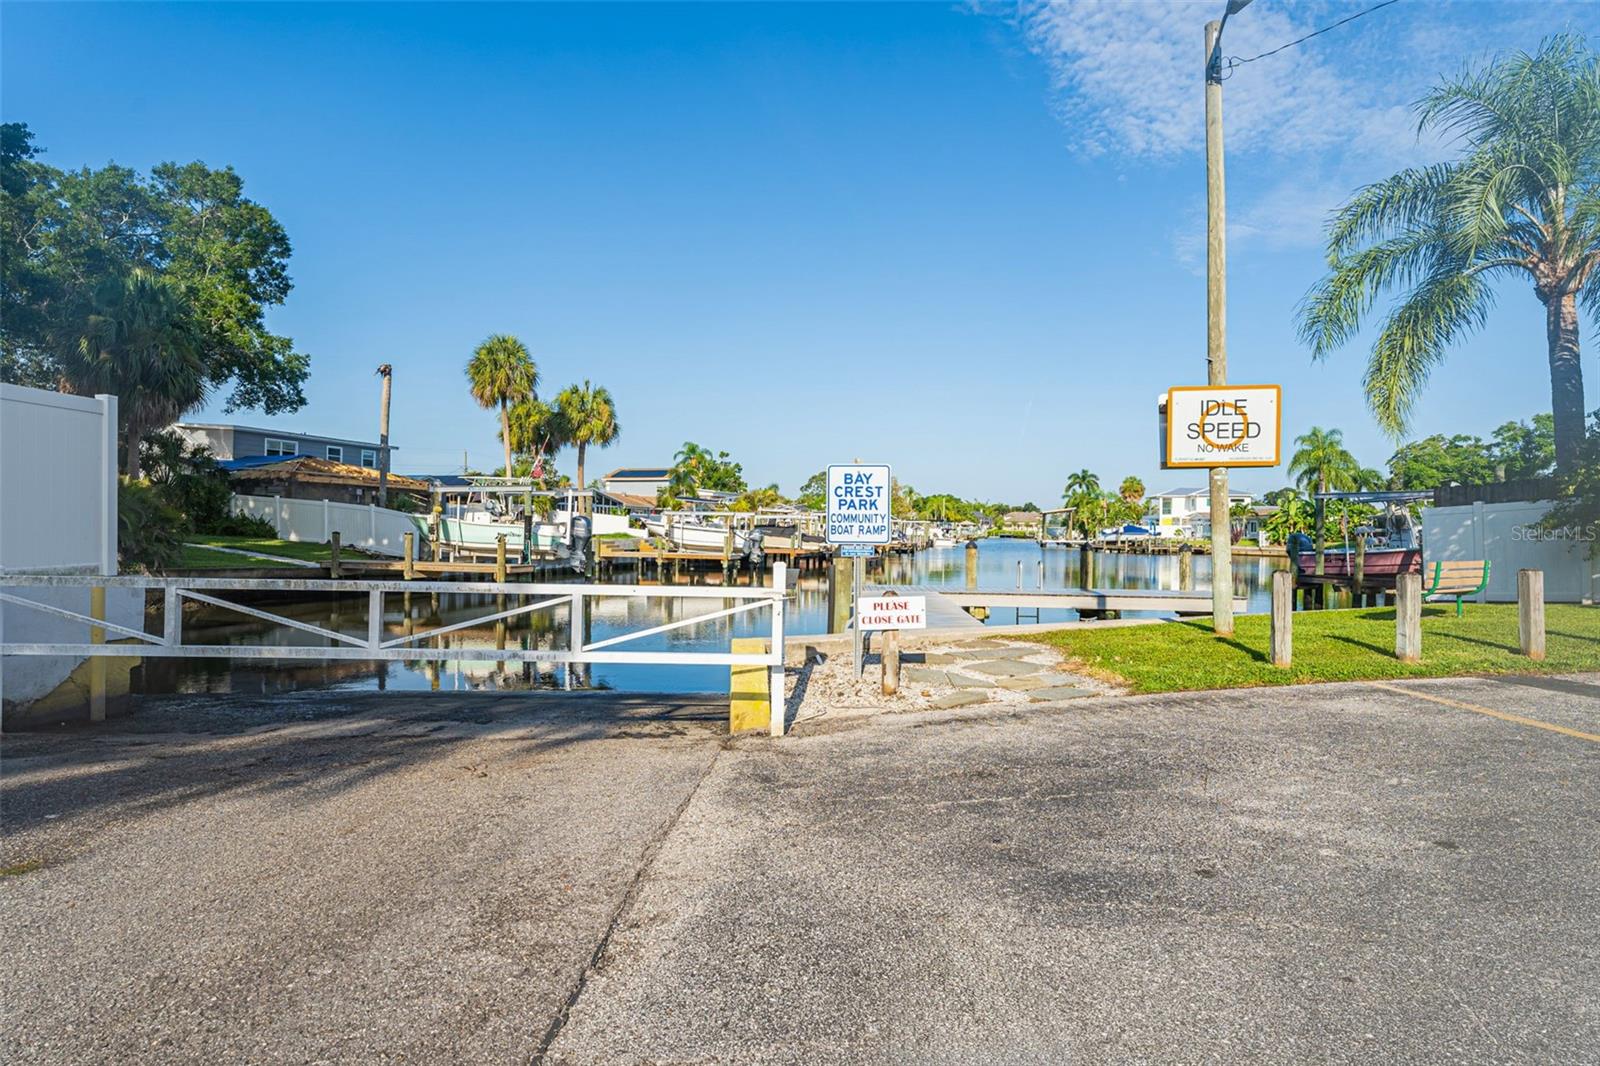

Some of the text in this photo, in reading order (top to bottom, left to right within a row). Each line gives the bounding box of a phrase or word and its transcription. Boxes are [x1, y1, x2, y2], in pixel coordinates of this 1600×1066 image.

[1200, 399, 1247, 416] IDLE
[1187, 422, 1261, 439] SPEED
[1197, 443, 1249, 453] NO WAKE
[844, 473, 872, 484] BAY
[834, 486, 883, 497] CREST
[838, 499, 878, 510] PARK
[831, 513, 886, 523] COMMUNITY
[831, 525, 886, 534] BOAT RAMP
[873, 602, 909, 610] PLEASE
[862, 615, 920, 624] CLOSE GATE
